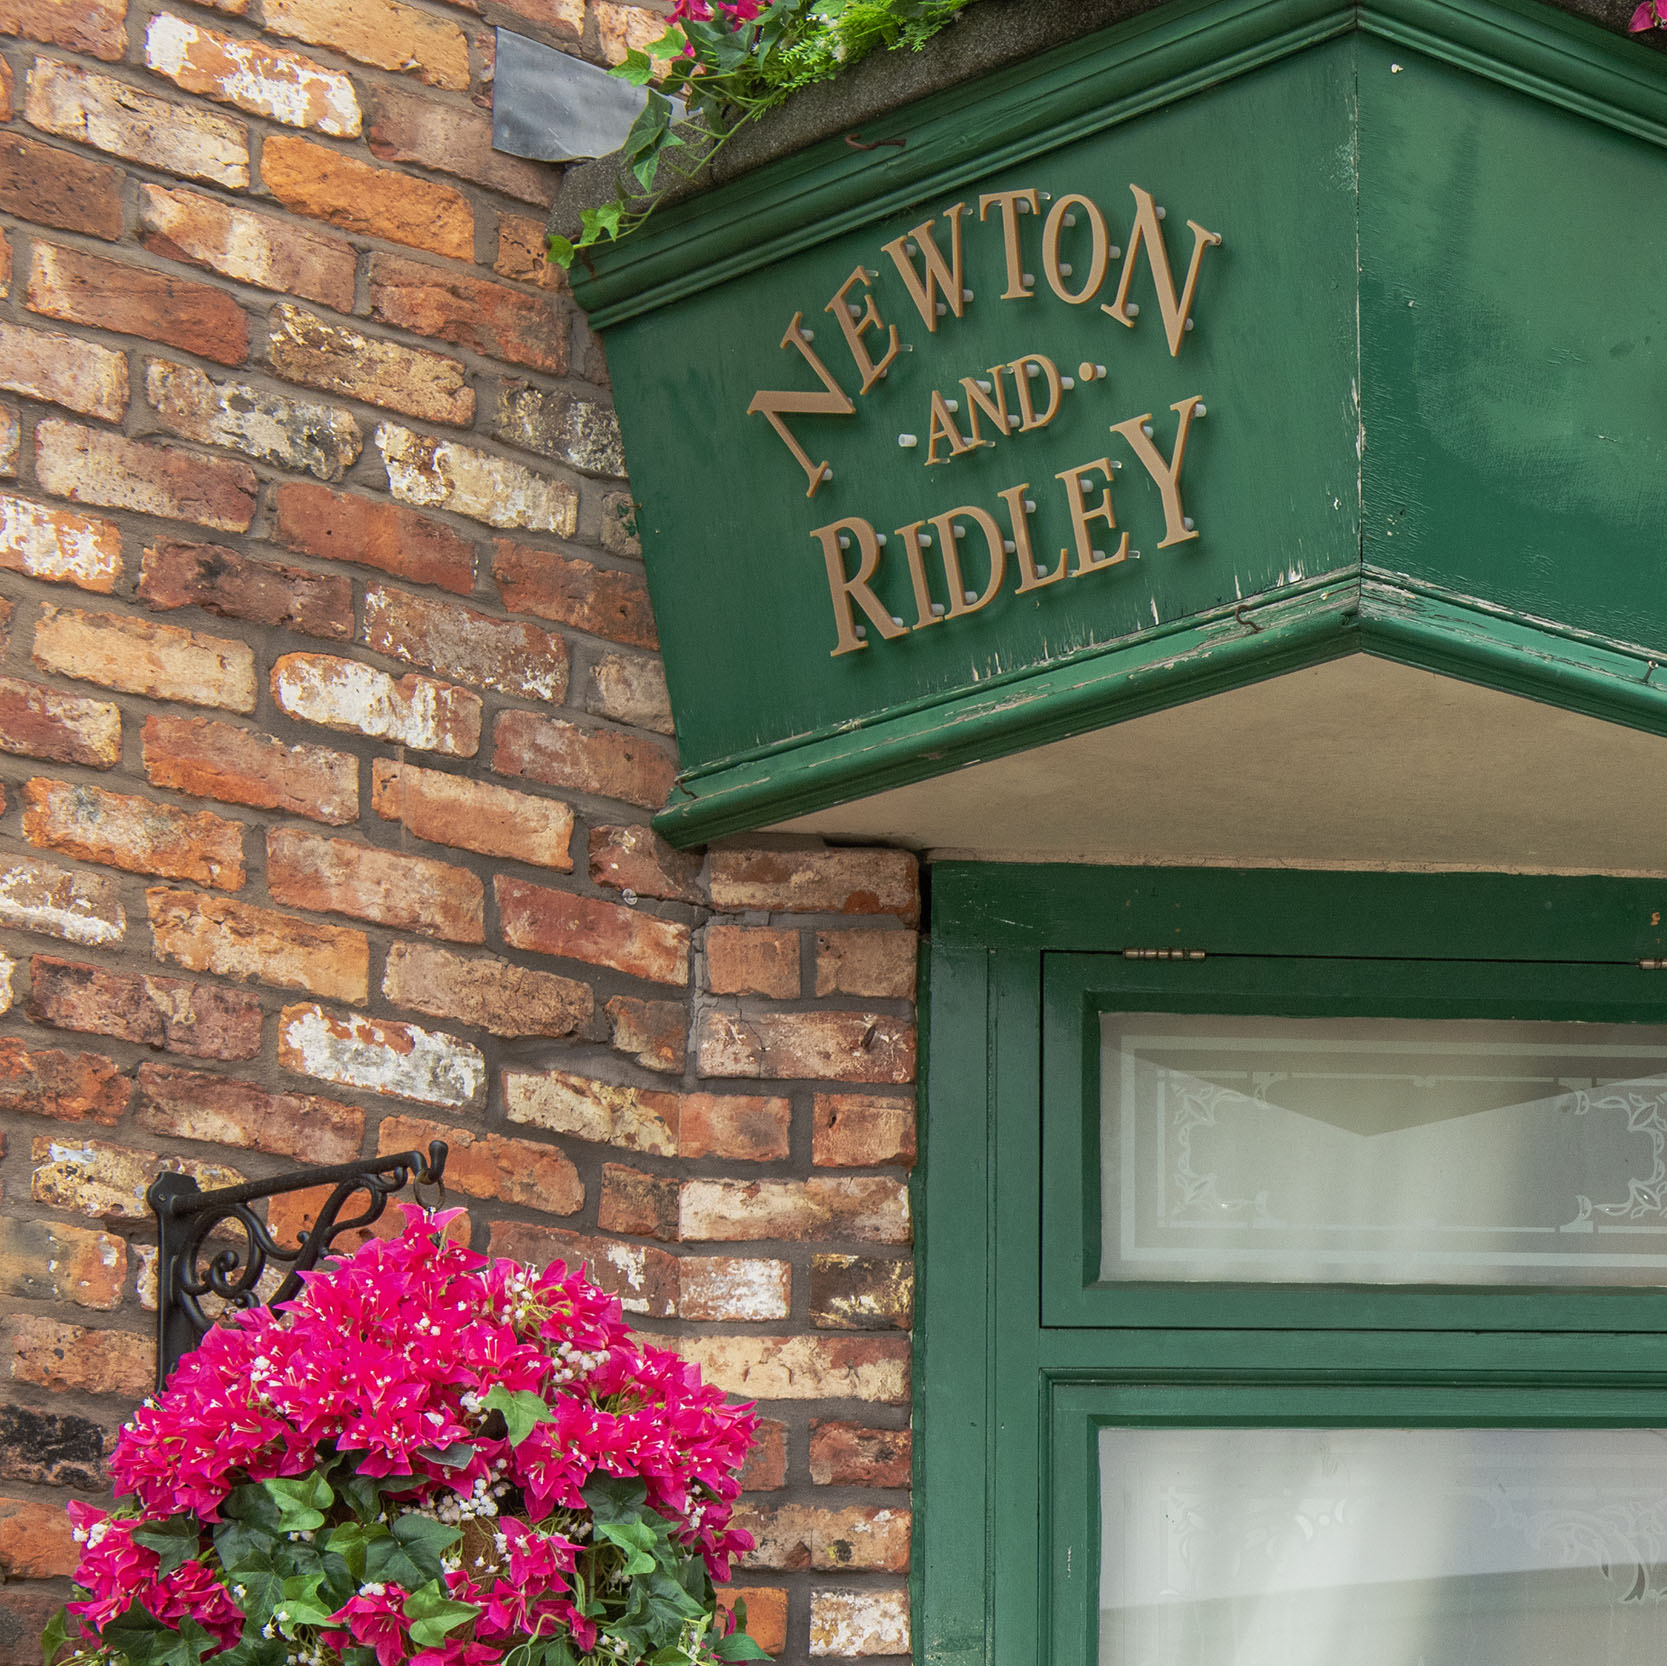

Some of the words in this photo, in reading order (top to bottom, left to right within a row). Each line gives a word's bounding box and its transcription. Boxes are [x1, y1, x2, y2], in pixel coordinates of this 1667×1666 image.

[747, 183, 1217, 497] NEWTON
[924, 354, 1062, 466] AND
[809, 395, 1202, 657] RIDLEY
